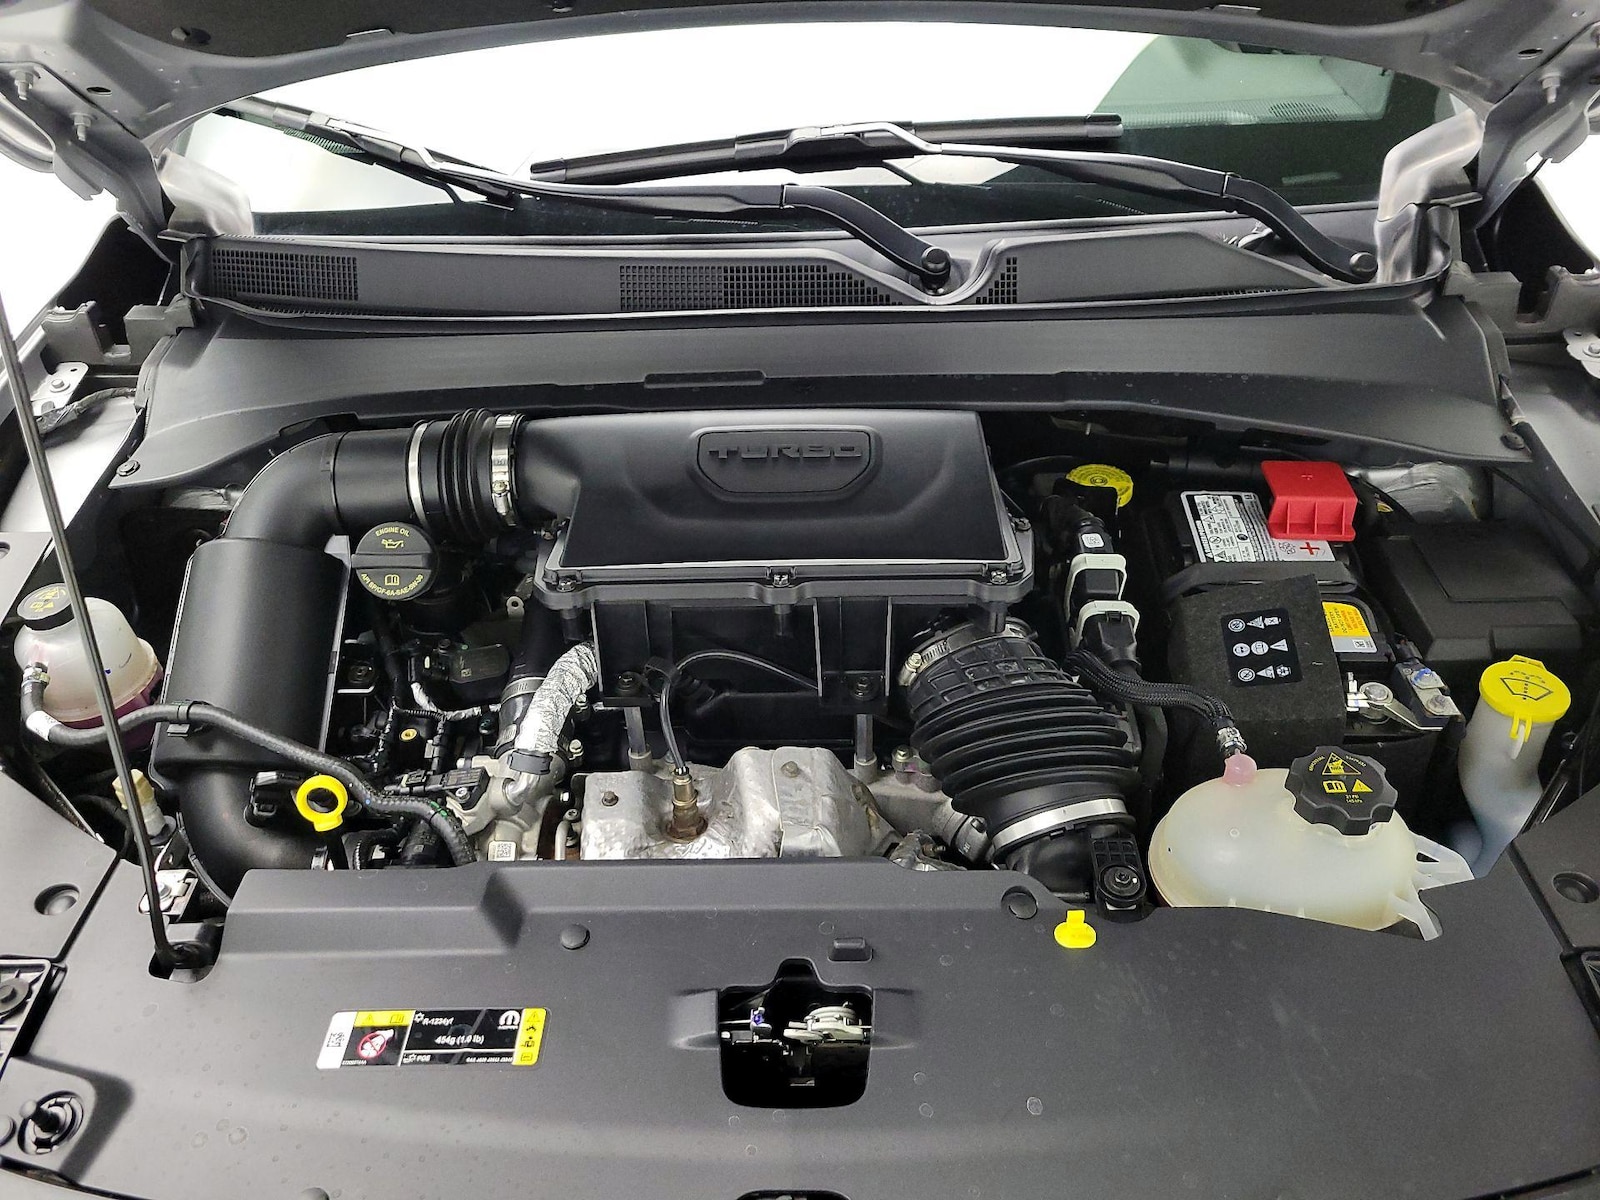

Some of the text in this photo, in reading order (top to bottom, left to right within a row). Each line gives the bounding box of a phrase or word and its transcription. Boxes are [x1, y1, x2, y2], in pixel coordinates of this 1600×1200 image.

[708, 444, 862, 460] TURBO
[375, 527, 410, 537] ENGINE OIL
[361, 573, 370, 583] API
[422, 1017, 455, 1026] R-1234yf
[435, 1035, 456, 1046] 454g
[472, 1035, 485, 1045] lb)
